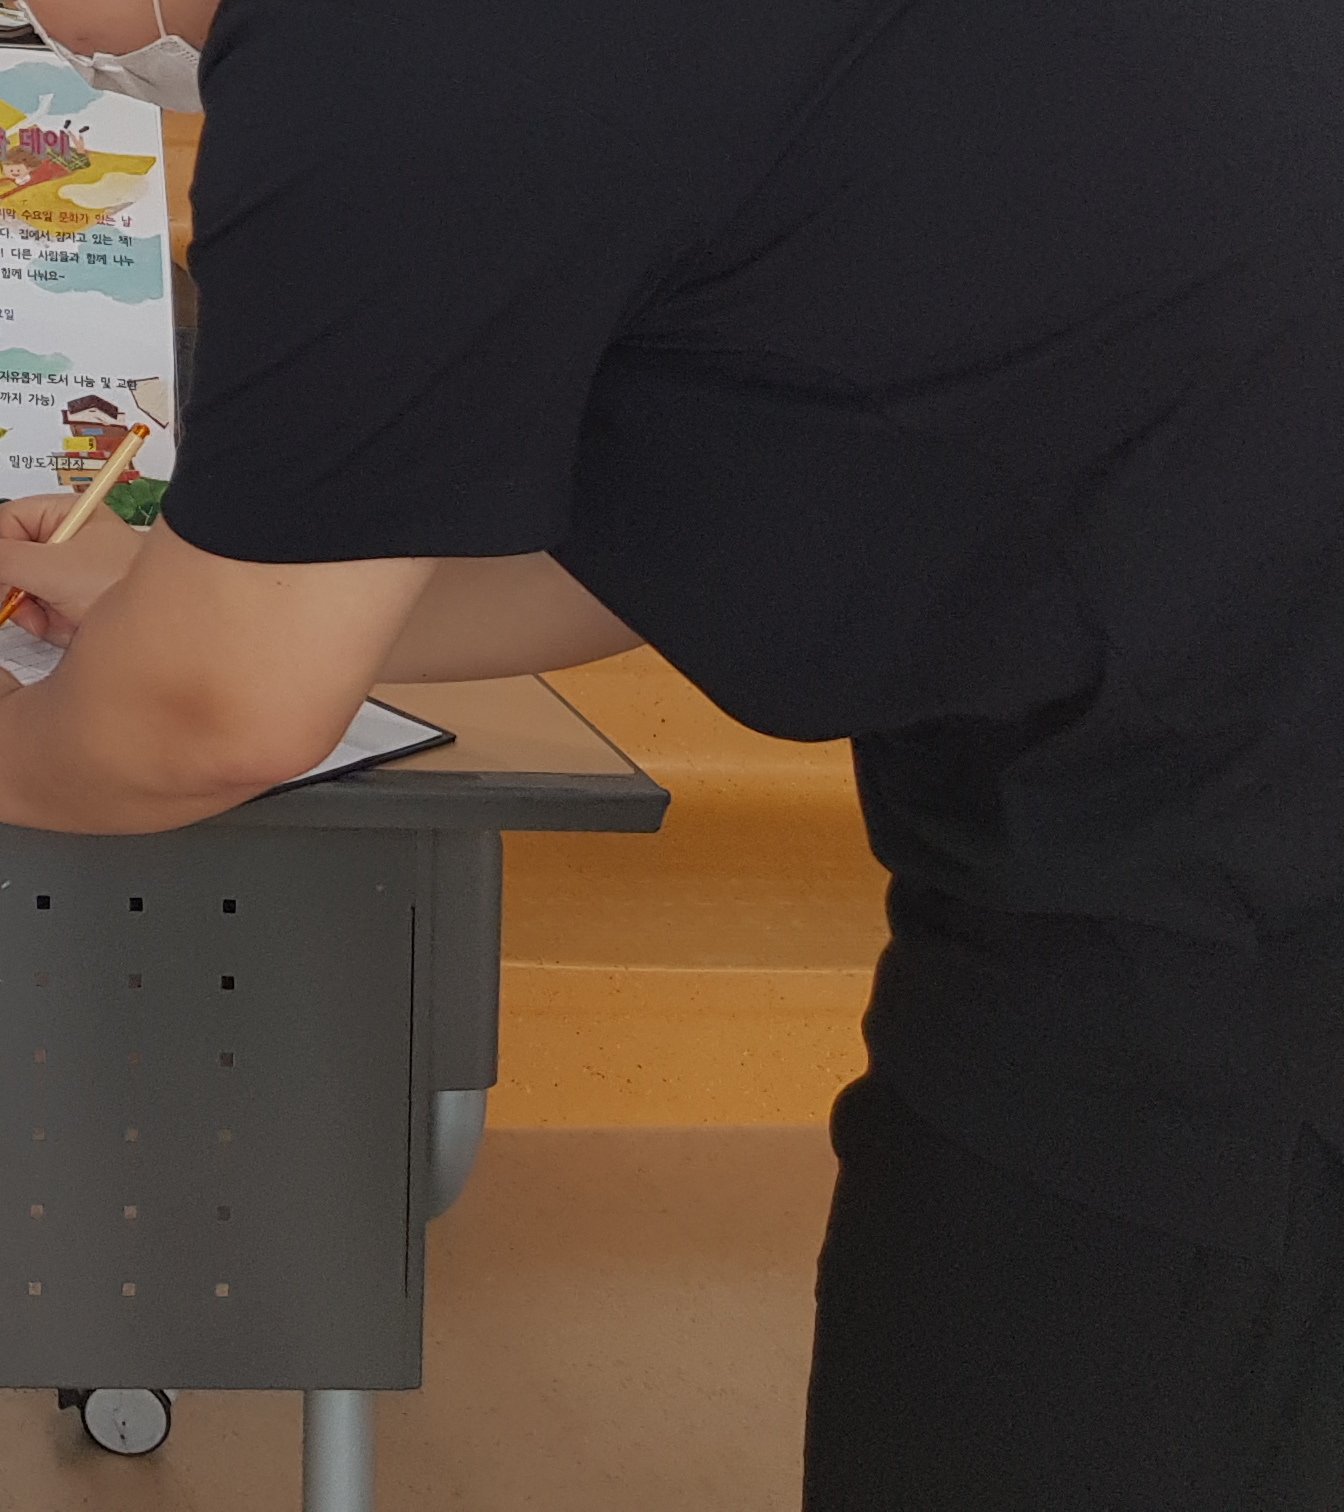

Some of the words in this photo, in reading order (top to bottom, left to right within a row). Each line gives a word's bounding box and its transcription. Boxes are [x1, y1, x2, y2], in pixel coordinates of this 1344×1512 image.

[19, 127, 71, 161] 데이
[21, 209, 52, 223] 수요일
[59, 212, 88, 225] 문화가
[95, 215, 116, 226] 있는
[19, 229, 49, 242] 집에서
[56, 231, 86, 243] 잠자고
[92, 234, 113, 245] 있는
[119, 236, 133, 247] 책!
[11, 247, 32, 260] 다른
[38, 250, 79, 263] 사람들과
[87, 253, 107, 265] 함께
[113, 256, 134, 267] 나누
[1, 267, 22, 280] 함께
[0, 371, 42, 385] 자유롭게
[47, 373, 69, 386] 도서
[74, 375, 96, 388] 나눔
[100, 377, 111, 389] 및
[28, 393, 55, 407] 가능)
